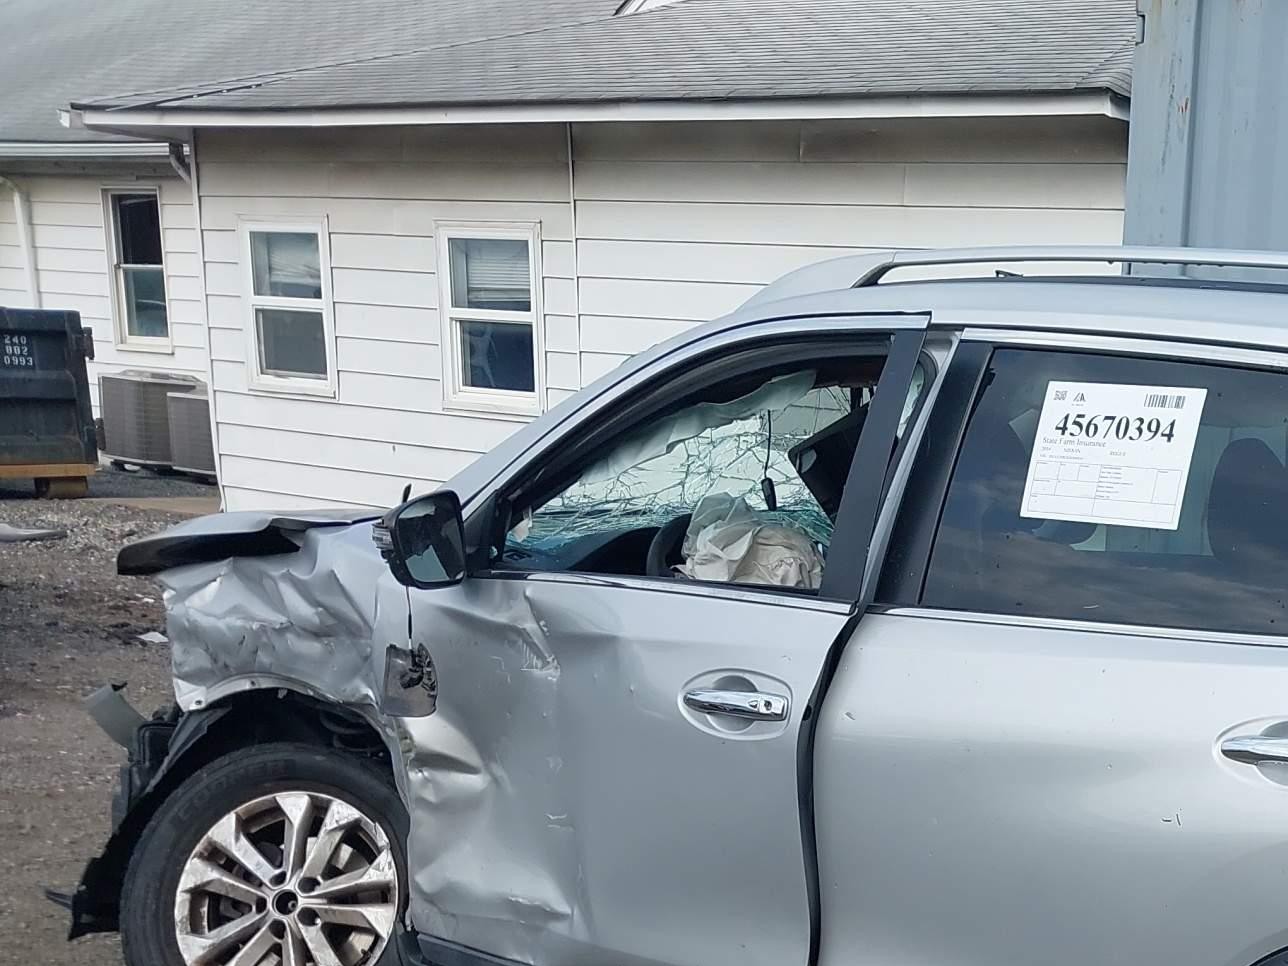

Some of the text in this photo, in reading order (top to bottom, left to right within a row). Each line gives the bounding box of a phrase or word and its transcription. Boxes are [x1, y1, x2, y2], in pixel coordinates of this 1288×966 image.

[3, 334, 27, 345] 240
[4, 355, 33, 366] 0993
[1055, 412, 1177, 443] 45670394
[1042, 437, 1107, 448] State Farm Insurance
